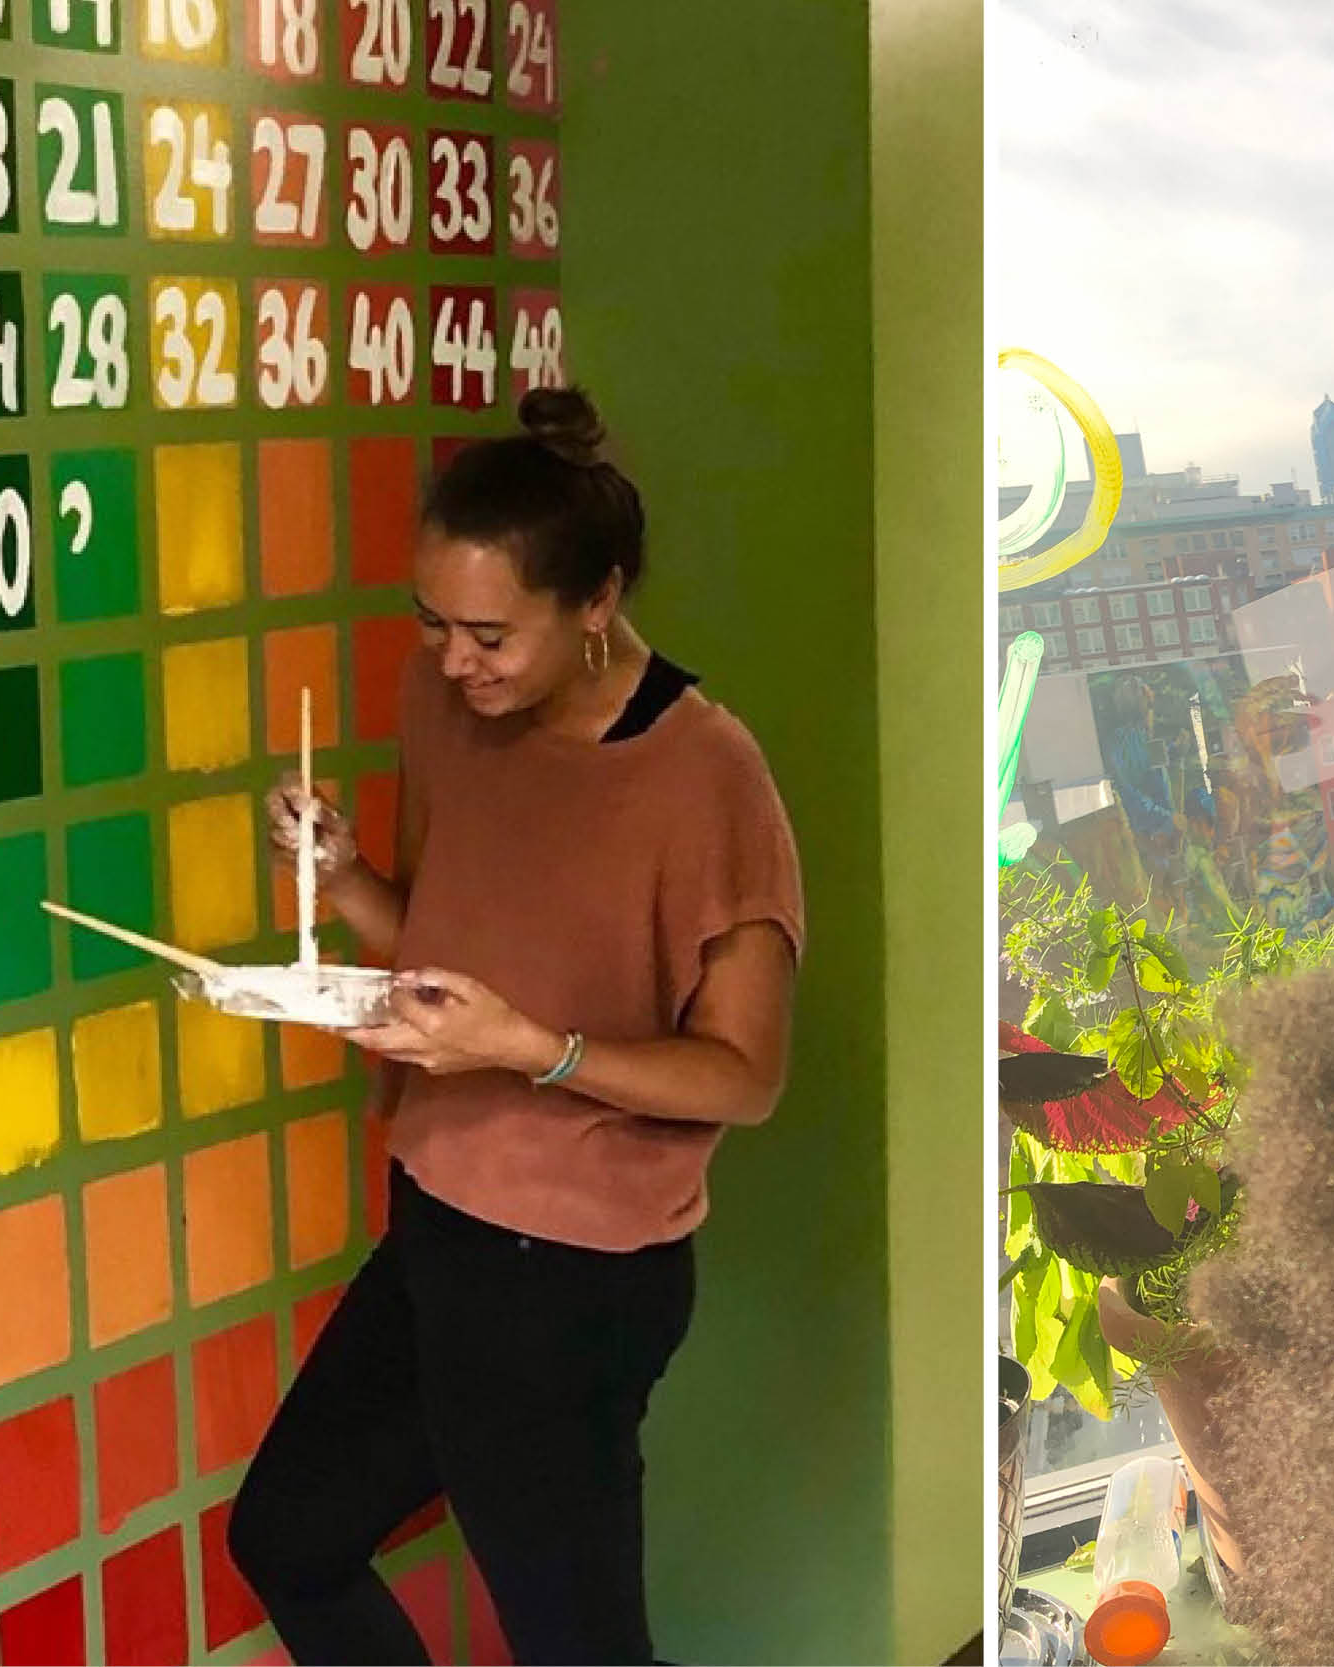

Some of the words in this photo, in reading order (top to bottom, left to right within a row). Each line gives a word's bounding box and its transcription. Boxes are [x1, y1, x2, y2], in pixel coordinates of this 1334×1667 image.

[350, 0, 410, 84] 20
[429, 0, 491, 95] 22
[507, 1, 553, 103] 24
[38, 98, 118, 225] 21
[150, 106, 232, 233] 24
[253, 117, 325, 236] 27
[348, 128, 412, 249] 30
[432, 138, 491, 241] 33
[510, 155, 558, 246] 36
[51, 293, 129, 408] 28
[155, 287, 235, 408] 32
[259, 289, 326, 408] 36
[350, 292, 413, 403] 40
[432, 297, 496, 403] 44
[510, 308, 563, 390] 48
